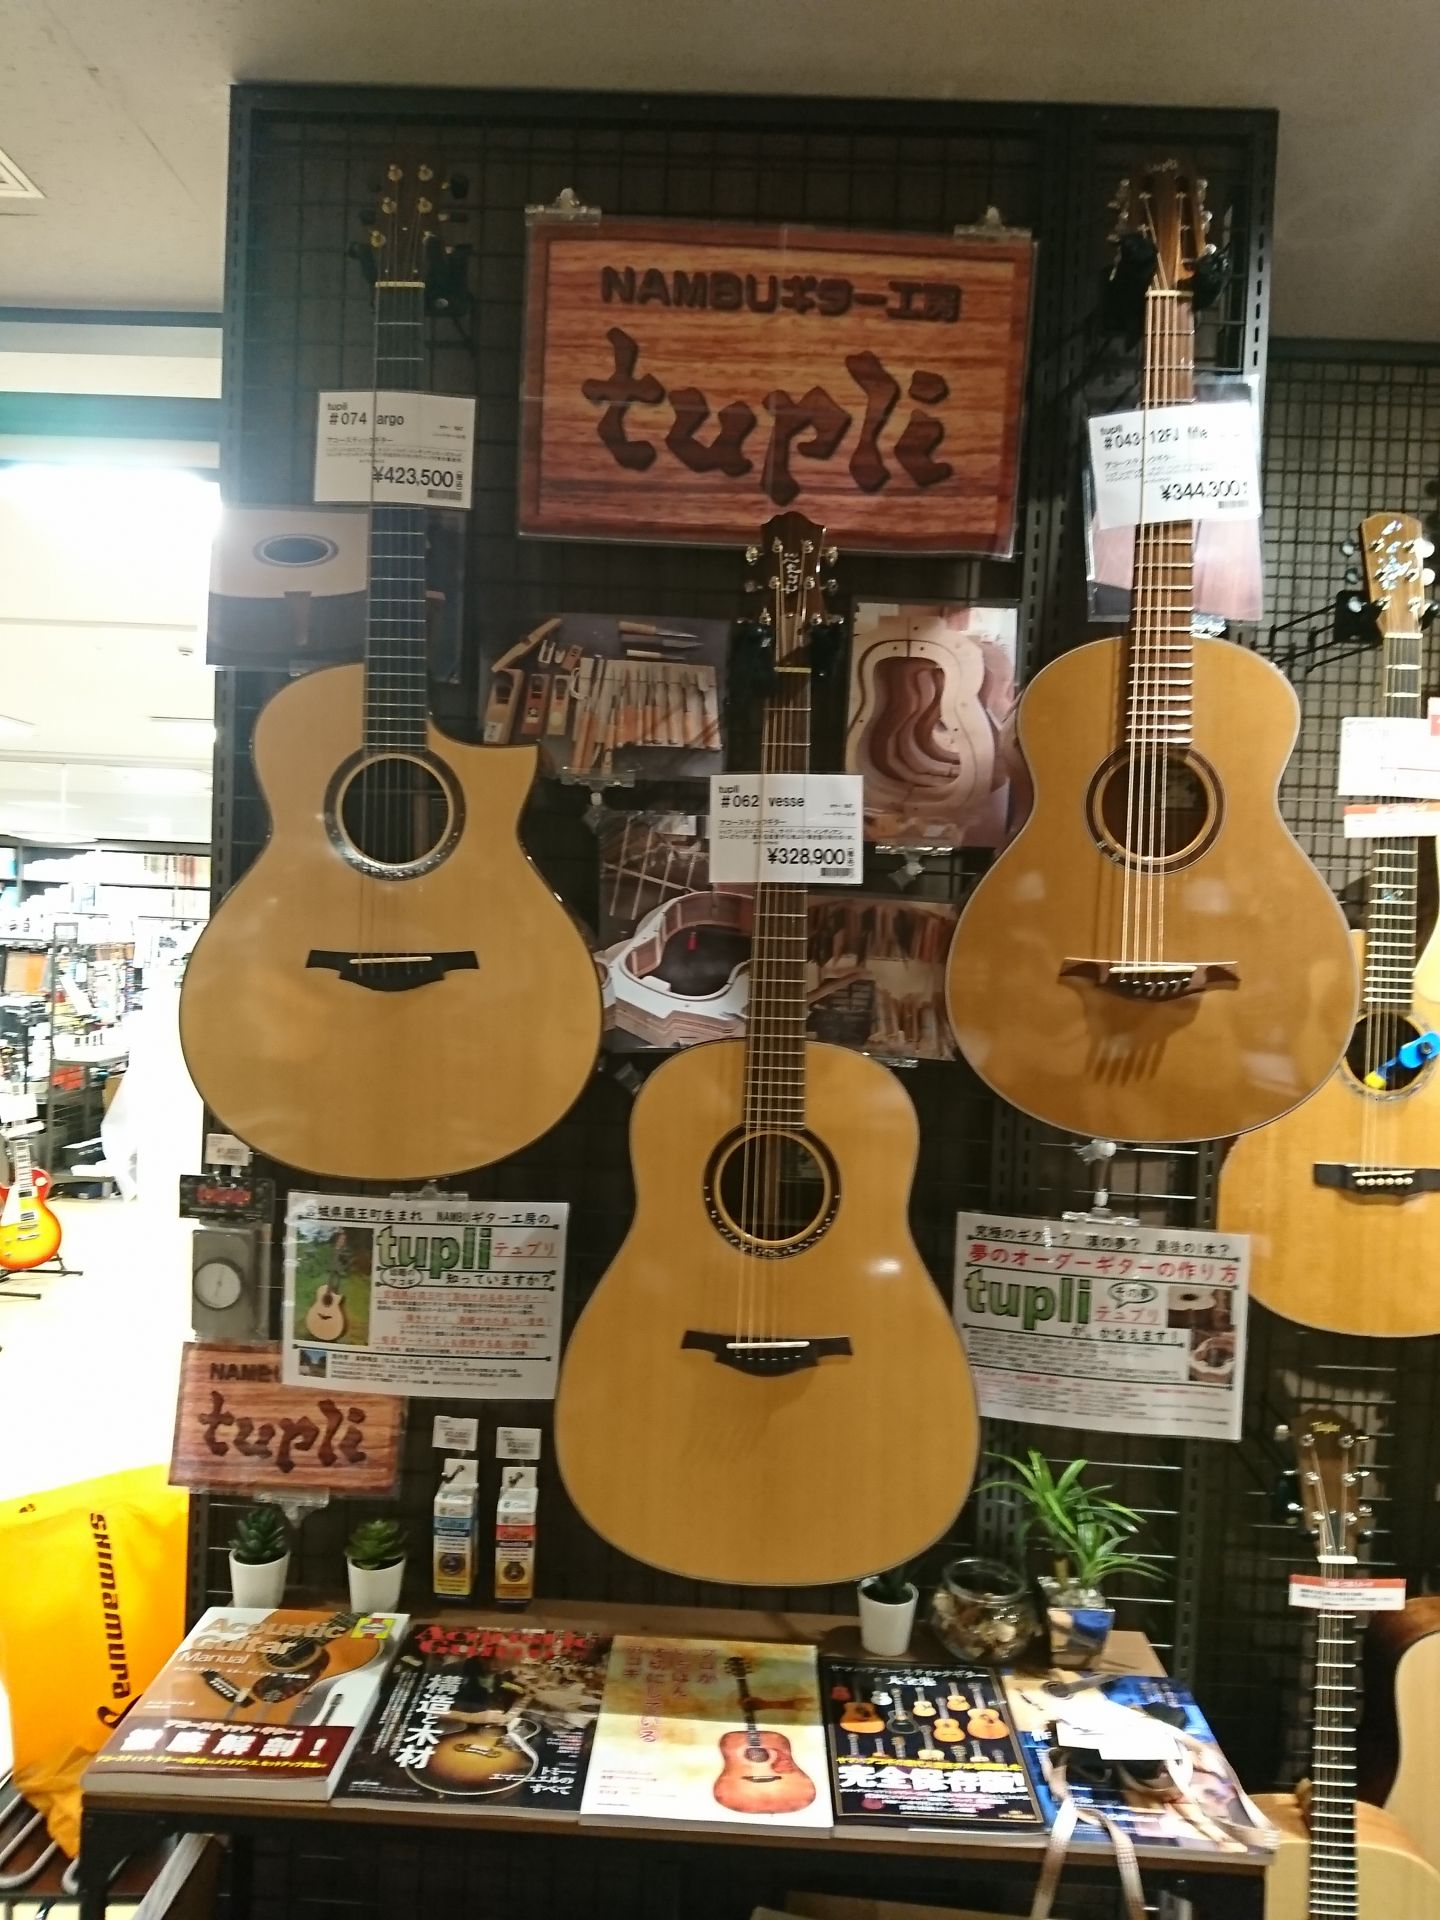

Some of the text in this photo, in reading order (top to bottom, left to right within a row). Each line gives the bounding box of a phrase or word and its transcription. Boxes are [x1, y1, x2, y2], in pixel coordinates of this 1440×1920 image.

[601, 265, 962, 323] NAMBUギター工房
[329, 412, 405, 427] #074 argo
[582, 327, 953, 507] tupli
[1104, 432, 1141, 450] #043
[372, 466, 454, 488] ¥423,500
[721, 795, 805, 808] #062 vesse
[767, 847, 845, 866] ¥328,900
[376, 1225, 493, 1280] tupli
[969, 1243, 1240, 1283] 夢のオーダーギターの作り方
[445, 1273, 551, 1288] 知っていますか?
[964, 1269, 1093, 1331] tupli
[198, 1390, 367, 1473] tupli
[200, 1617, 347, 1639] Acoustic
[191, 1634, 298, 1655] Guitar
[178, 1651, 252, 1665] Manual
[393, 1674, 464, 1770] 構造と木材
[529, 1783, 574, 1795] すべて
